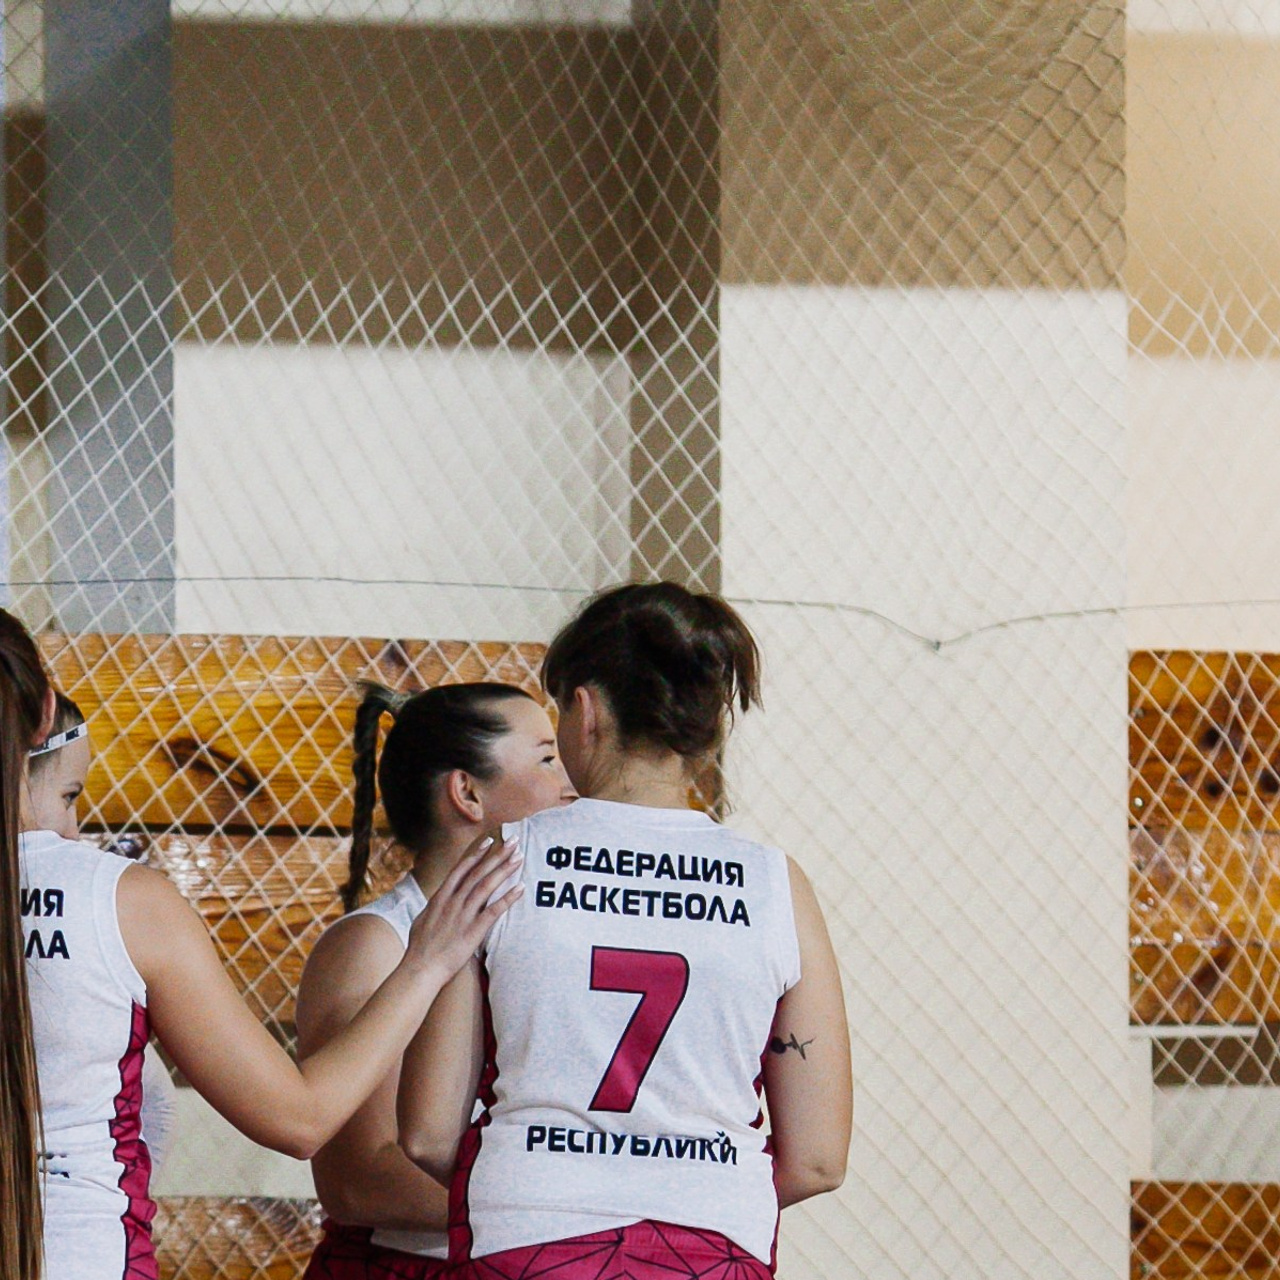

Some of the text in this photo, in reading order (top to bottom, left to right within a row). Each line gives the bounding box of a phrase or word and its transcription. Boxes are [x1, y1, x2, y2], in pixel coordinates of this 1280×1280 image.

[546, 846, 744, 887] ФЕДЕРАЦИЯ
[536, 881, 750, 927] БАСКЕТБОЛА
[588, 945, 690, 1113] 7
